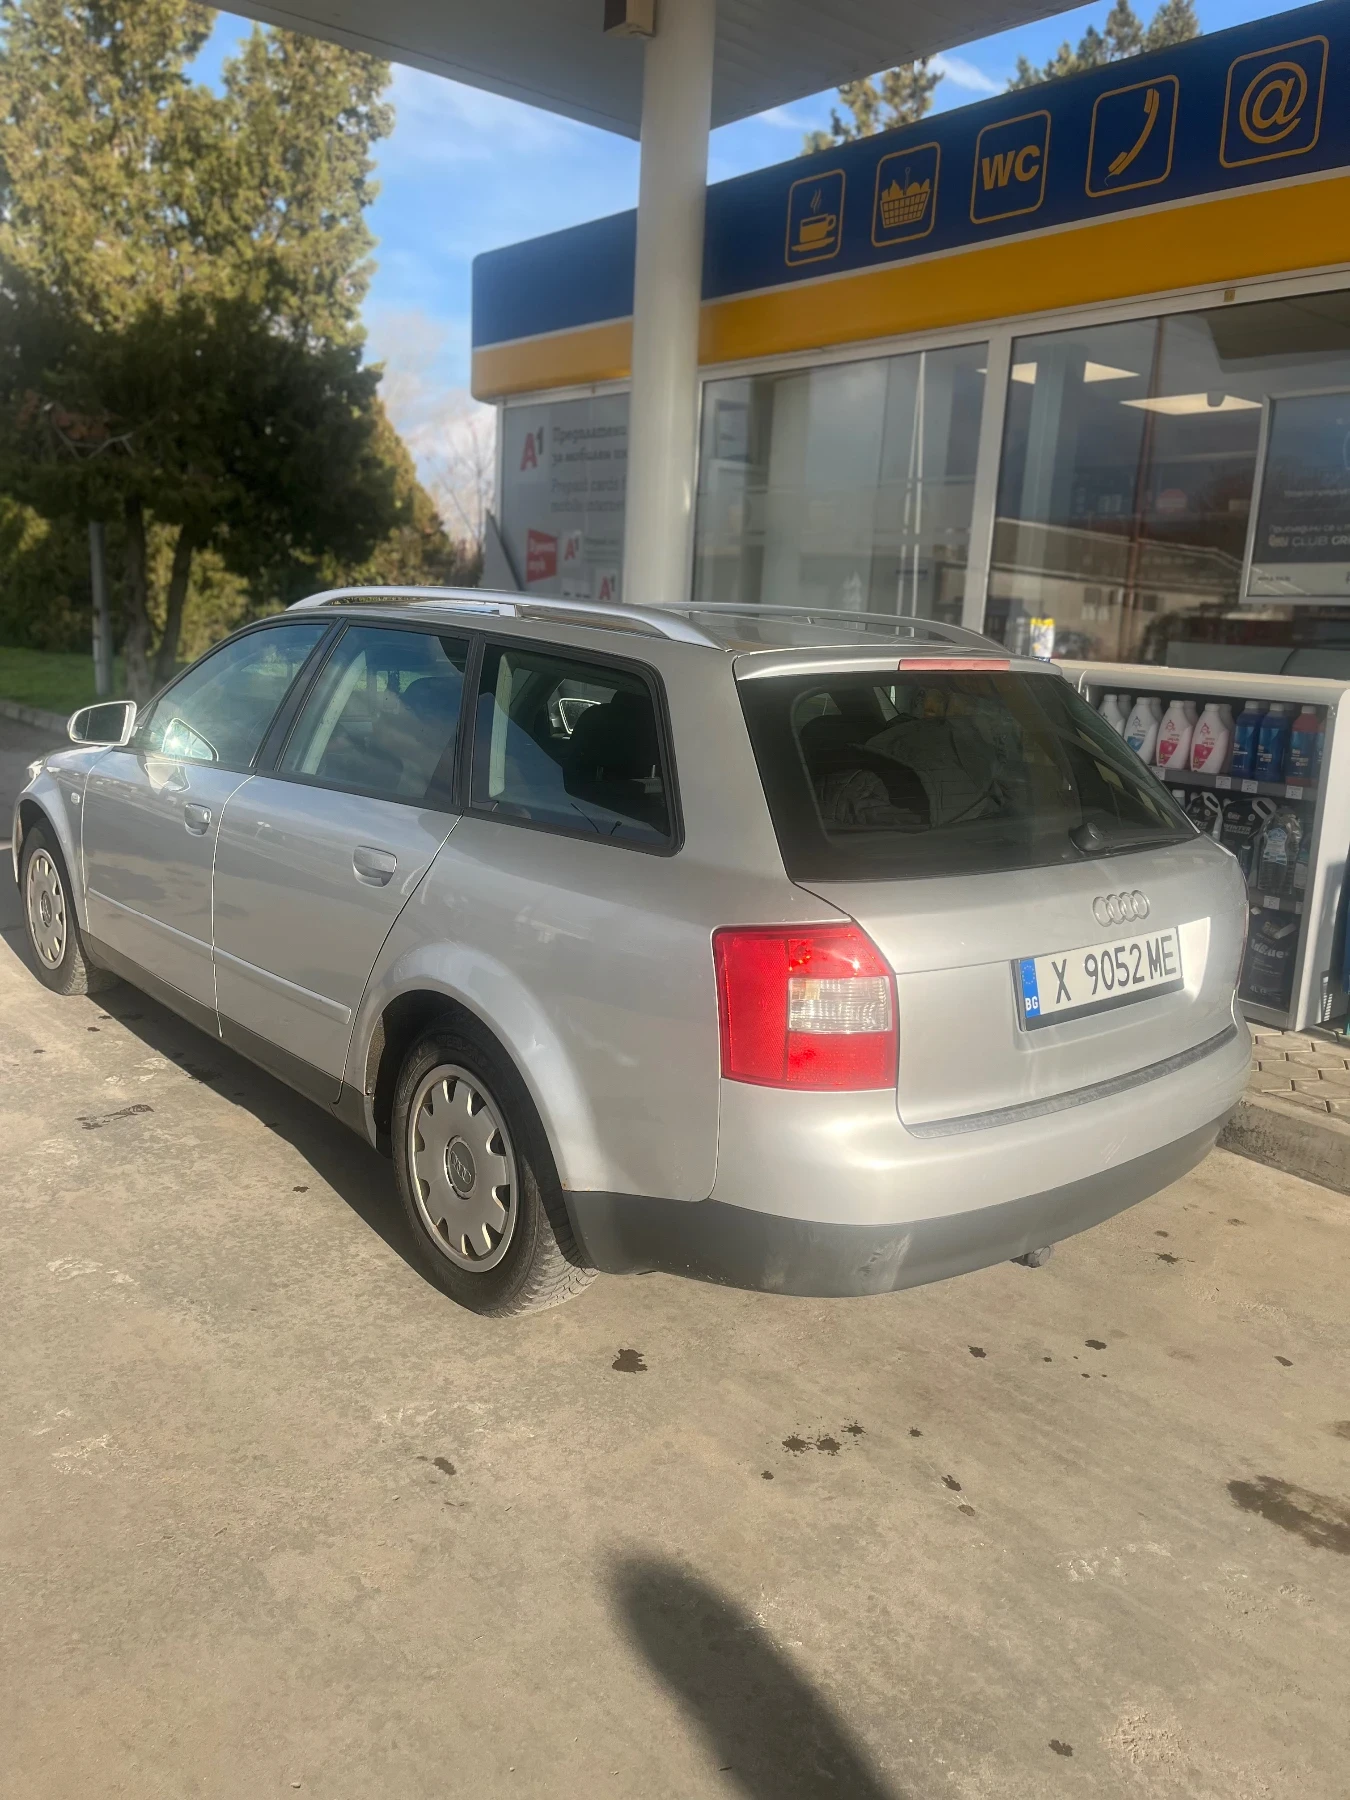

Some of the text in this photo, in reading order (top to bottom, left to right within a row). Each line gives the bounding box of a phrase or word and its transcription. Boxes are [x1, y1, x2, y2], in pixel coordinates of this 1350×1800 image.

[982, 144, 1041, 191] WC
[520, 426, 544, 470] A1
[1292, 535, 1328, 547] CLUB
[1051, 959, 1072, 1004] X
[1025, 997, 1039, 1012] BG
